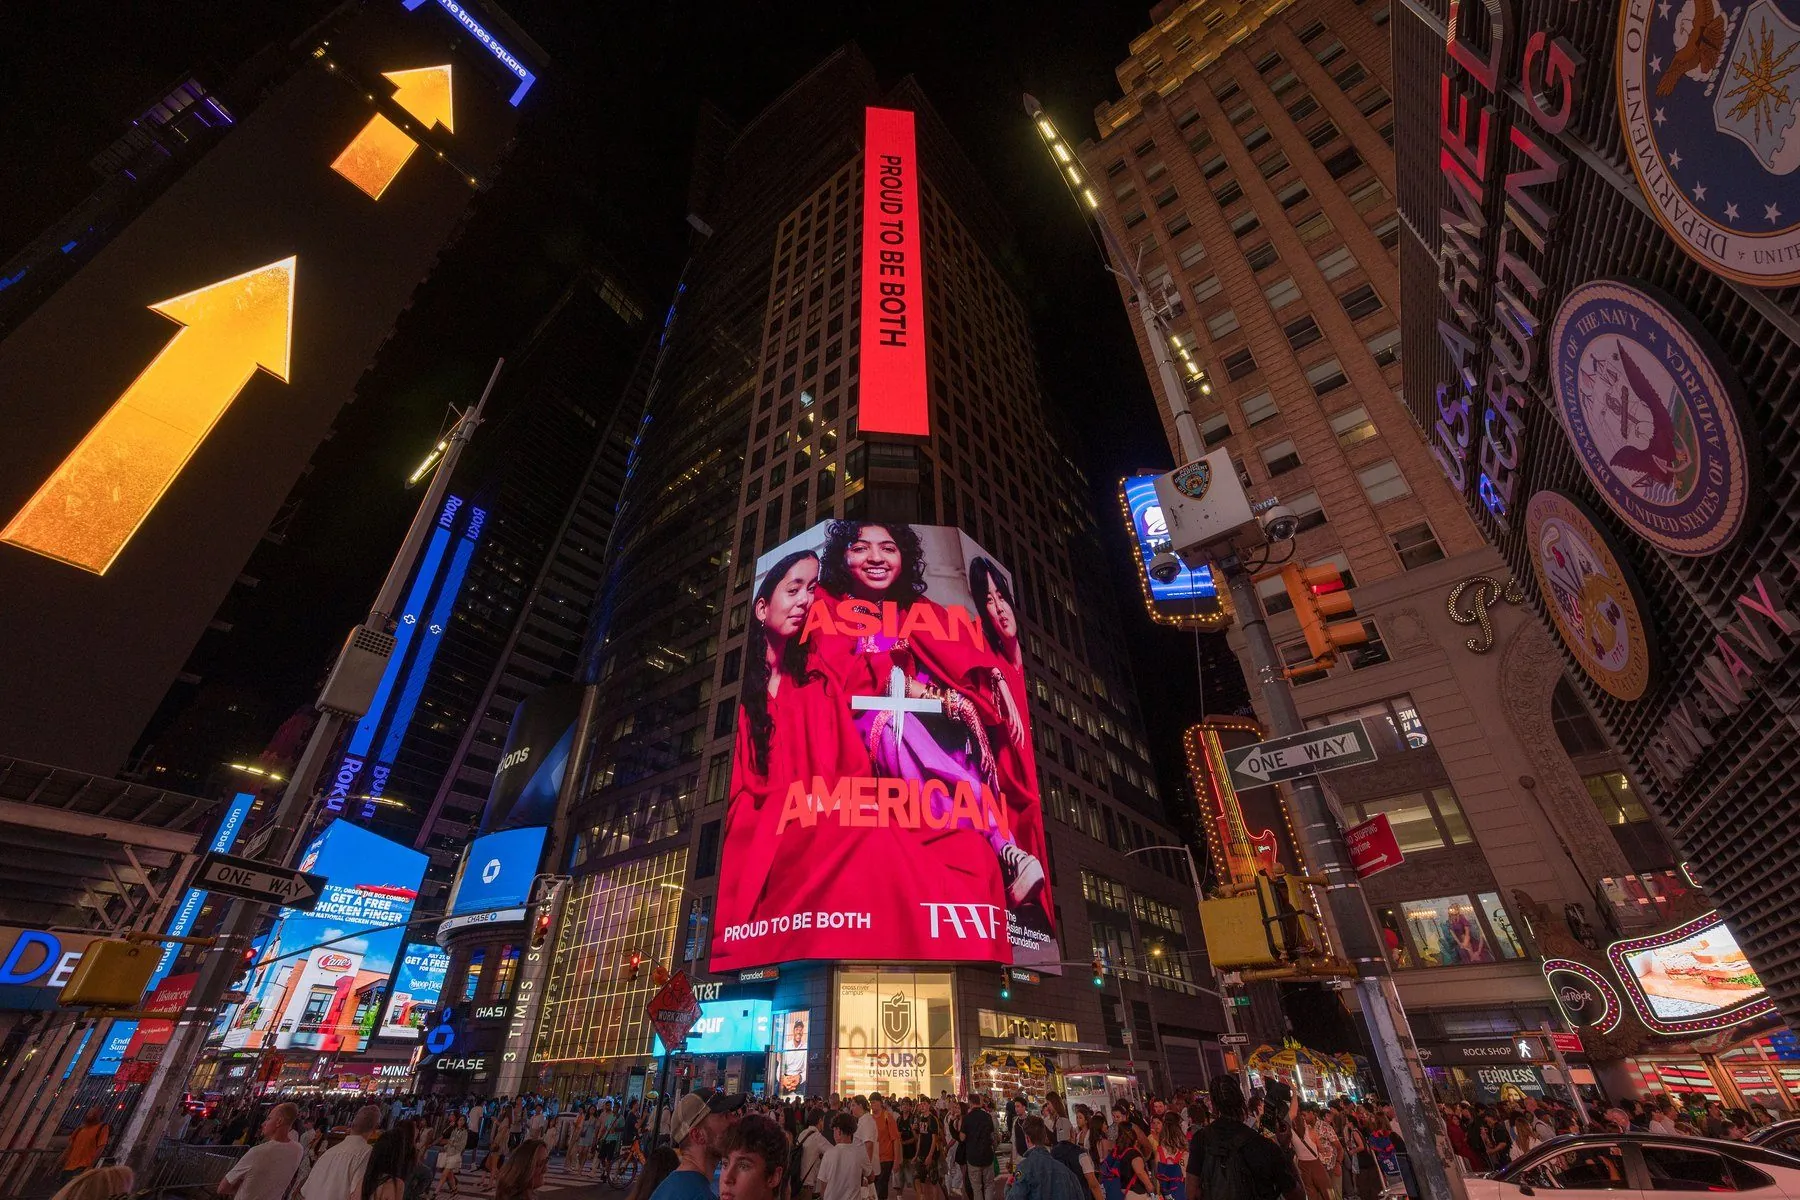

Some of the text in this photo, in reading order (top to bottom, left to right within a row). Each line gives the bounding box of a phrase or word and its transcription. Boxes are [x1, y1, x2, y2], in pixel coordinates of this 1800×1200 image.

[458, 10, 491, 43] times
[489, 40, 527, 77] square
[1624, 78, 1729, 260] DEPARTMENT
[879, 154, 907, 348] PROUD TO BE BOTH
[1479, 31, 1578, 535] RECRUITING
[1566, 335, 1580, 359] OF
[1576, 312, 1600, 336] THE
[1600, 307, 1640, 333] NAVY
[1625, 342, 1726, 534] UNITED STATES OF AMERICA
[799, 599, 984, 653] ASIAN
[1248, 752, 1288, 773] ONE
[1304, 736, 1348, 761] WAY
[776, 776, 1010, 841] AMERICAN
[217, 867, 306, 897] ONE WAY
[331, 892, 353, 904] GET
[353, 896, 362, 907] A
[364, 897, 392, 911] FREE
[315, 911, 344, 922] NATIONAL
[345, 916, 370, 925] CHICKEN
[363, 908, 403, 923] FINGER
[467, 913, 490, 924] CHASE
[1004, 909, 1017, 922] The
[724, 912, 871, 943] PROUD TO BE BOTH
[1006, 922, 1051, 943] Asian American
[1006, 932, 1040, 951] Foundation
[405, 956, 421, 965] GET
[421, 957, 428, 966] A
[429, 958, 450, 969] FREE
[1570, 990, 1592, 1003] Rock
[503, 981, 533, 1062] 3 TIMES
[658, 1010, 675, 1021] WORK
[689, 1017, 724, 1033] our
[1012, 1019, 1058, 1042] TOURO
[867, 1052, 927, 1068] TOURO
[1463, 1047, 1512, 1056] ROCK SHOP
[436, 1058, 485, 1070] CHASE
[868, 1069, 925, 1078] UNIVERSITY
[1478, 1068, 1536, 1084] FEARLESS
